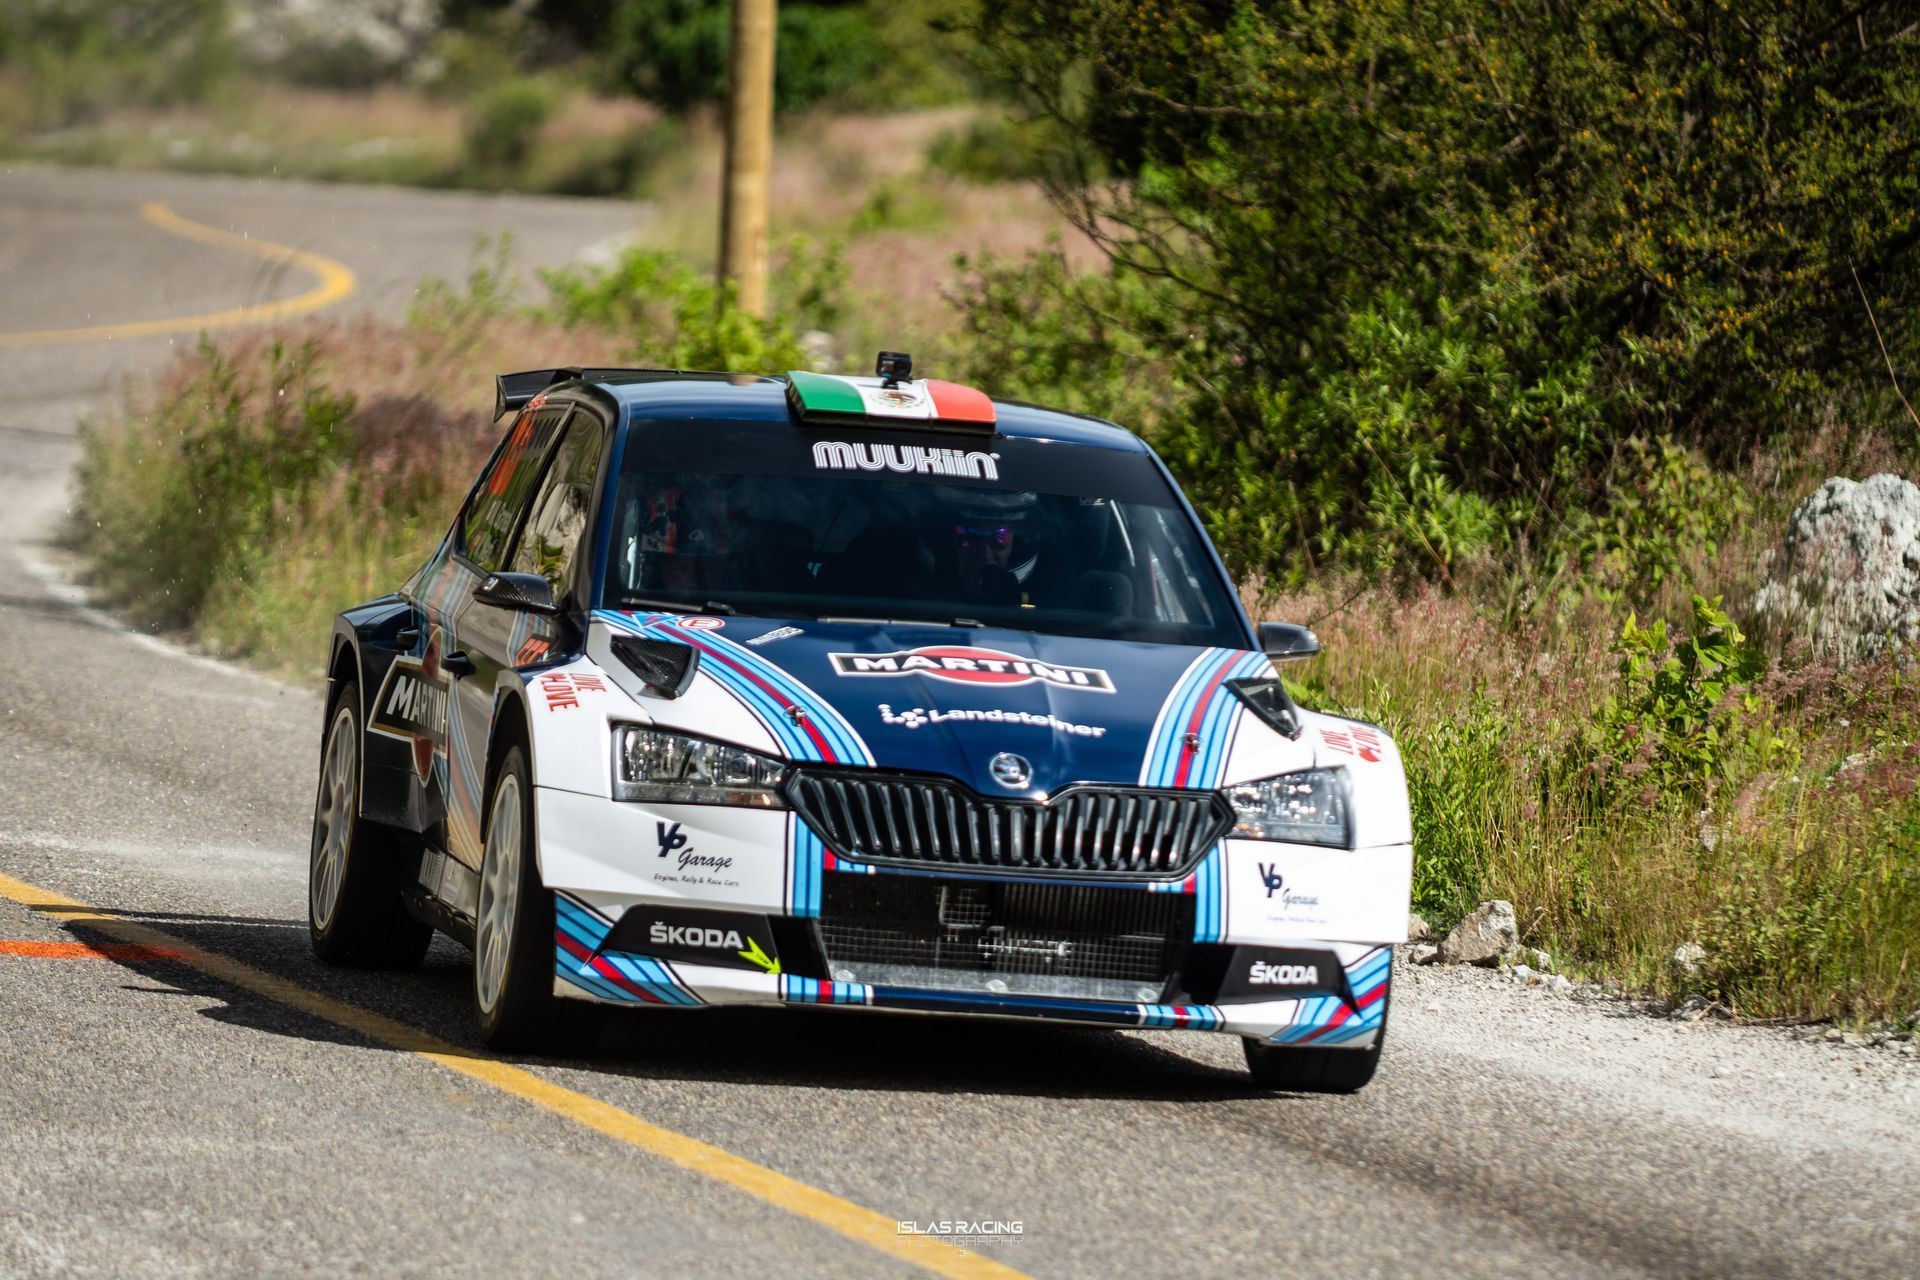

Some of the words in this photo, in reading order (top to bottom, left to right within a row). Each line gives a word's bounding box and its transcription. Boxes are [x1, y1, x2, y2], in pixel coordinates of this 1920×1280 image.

[853, 655, 1091, 686] MARTINI
[929, 709, 1107, 737] Landsteiner
[678, 847, 733, 873] Garage
[650, 921, 744, 949] ŠKODA
[1248, 961, 1318, 985] ŠKODA
